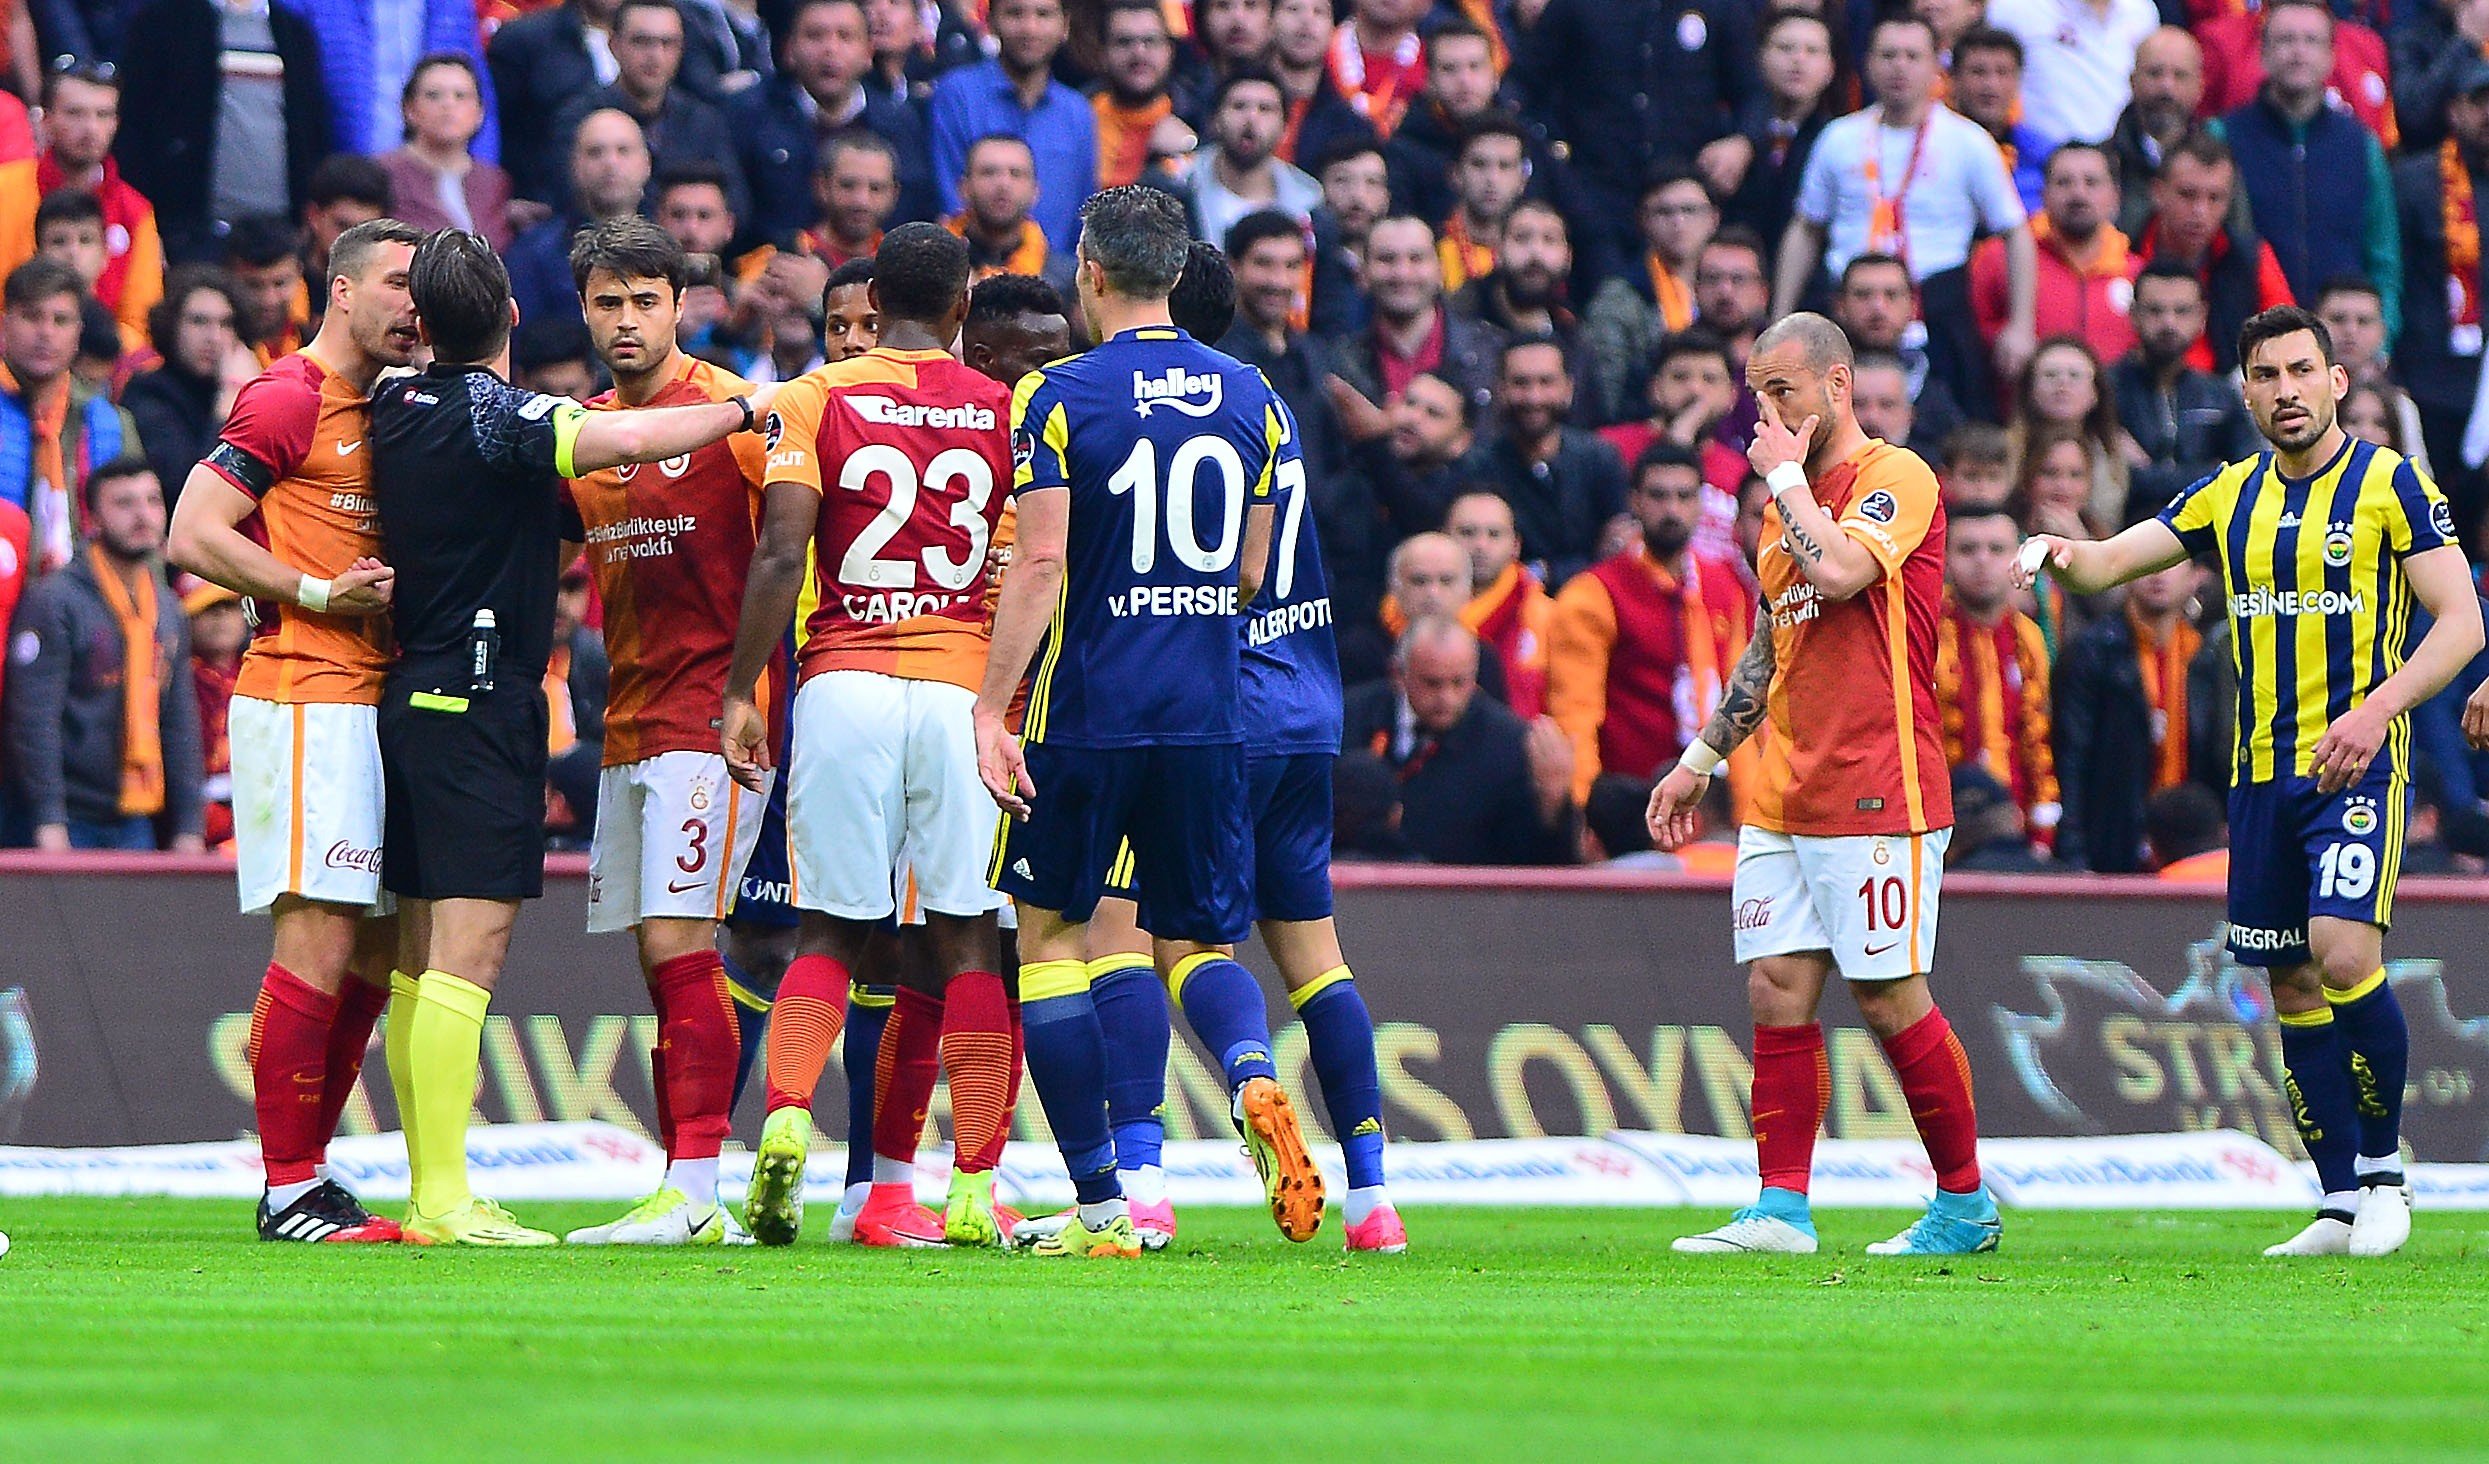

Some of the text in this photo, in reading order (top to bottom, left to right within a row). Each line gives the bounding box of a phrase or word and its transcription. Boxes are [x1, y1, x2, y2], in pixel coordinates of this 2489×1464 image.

[843, 394, 996, 430] Garenta
[1133, 367, 1223, 418] halley
[838, 443, 994, 590] 23
[1107, 435, 1246, 575] 10
[842, 591, 971, 624] CARO
[676, 818, 708, 873] 3
[2319, 842, 2376, 899] 19
[1858, 875, 1907, 931] 10
[2230, 924, 2306, 950] NTEGRAL
